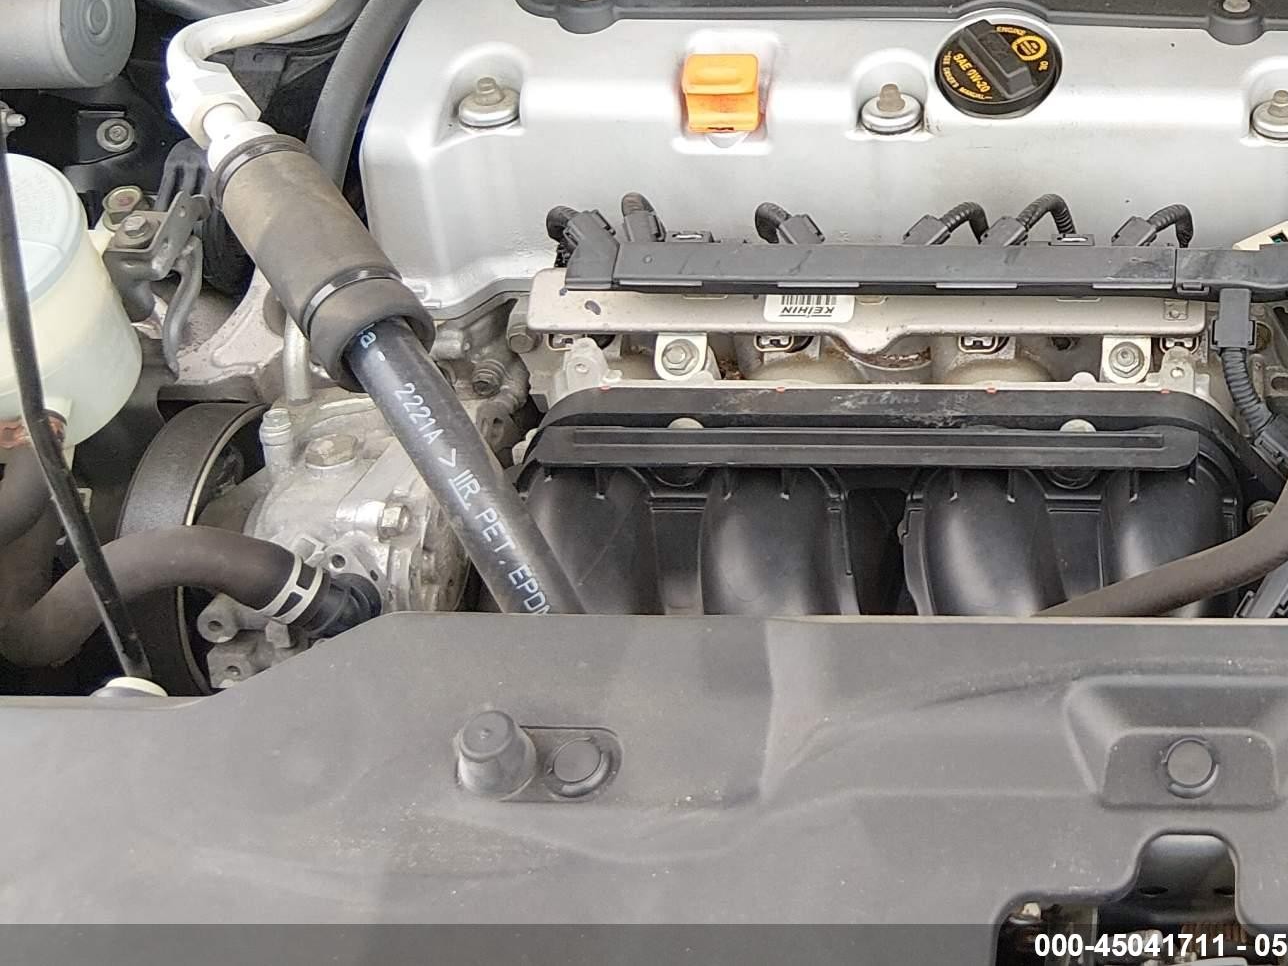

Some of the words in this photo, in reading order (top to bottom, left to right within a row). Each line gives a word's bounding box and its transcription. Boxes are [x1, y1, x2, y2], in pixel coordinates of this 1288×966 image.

[952, 52, 972, 72] SAE
[966, 65, 991, 93] 0W-20
[780, 306, 836, 314] KEIHIN
[394, 382, 445, 445] 2221A
